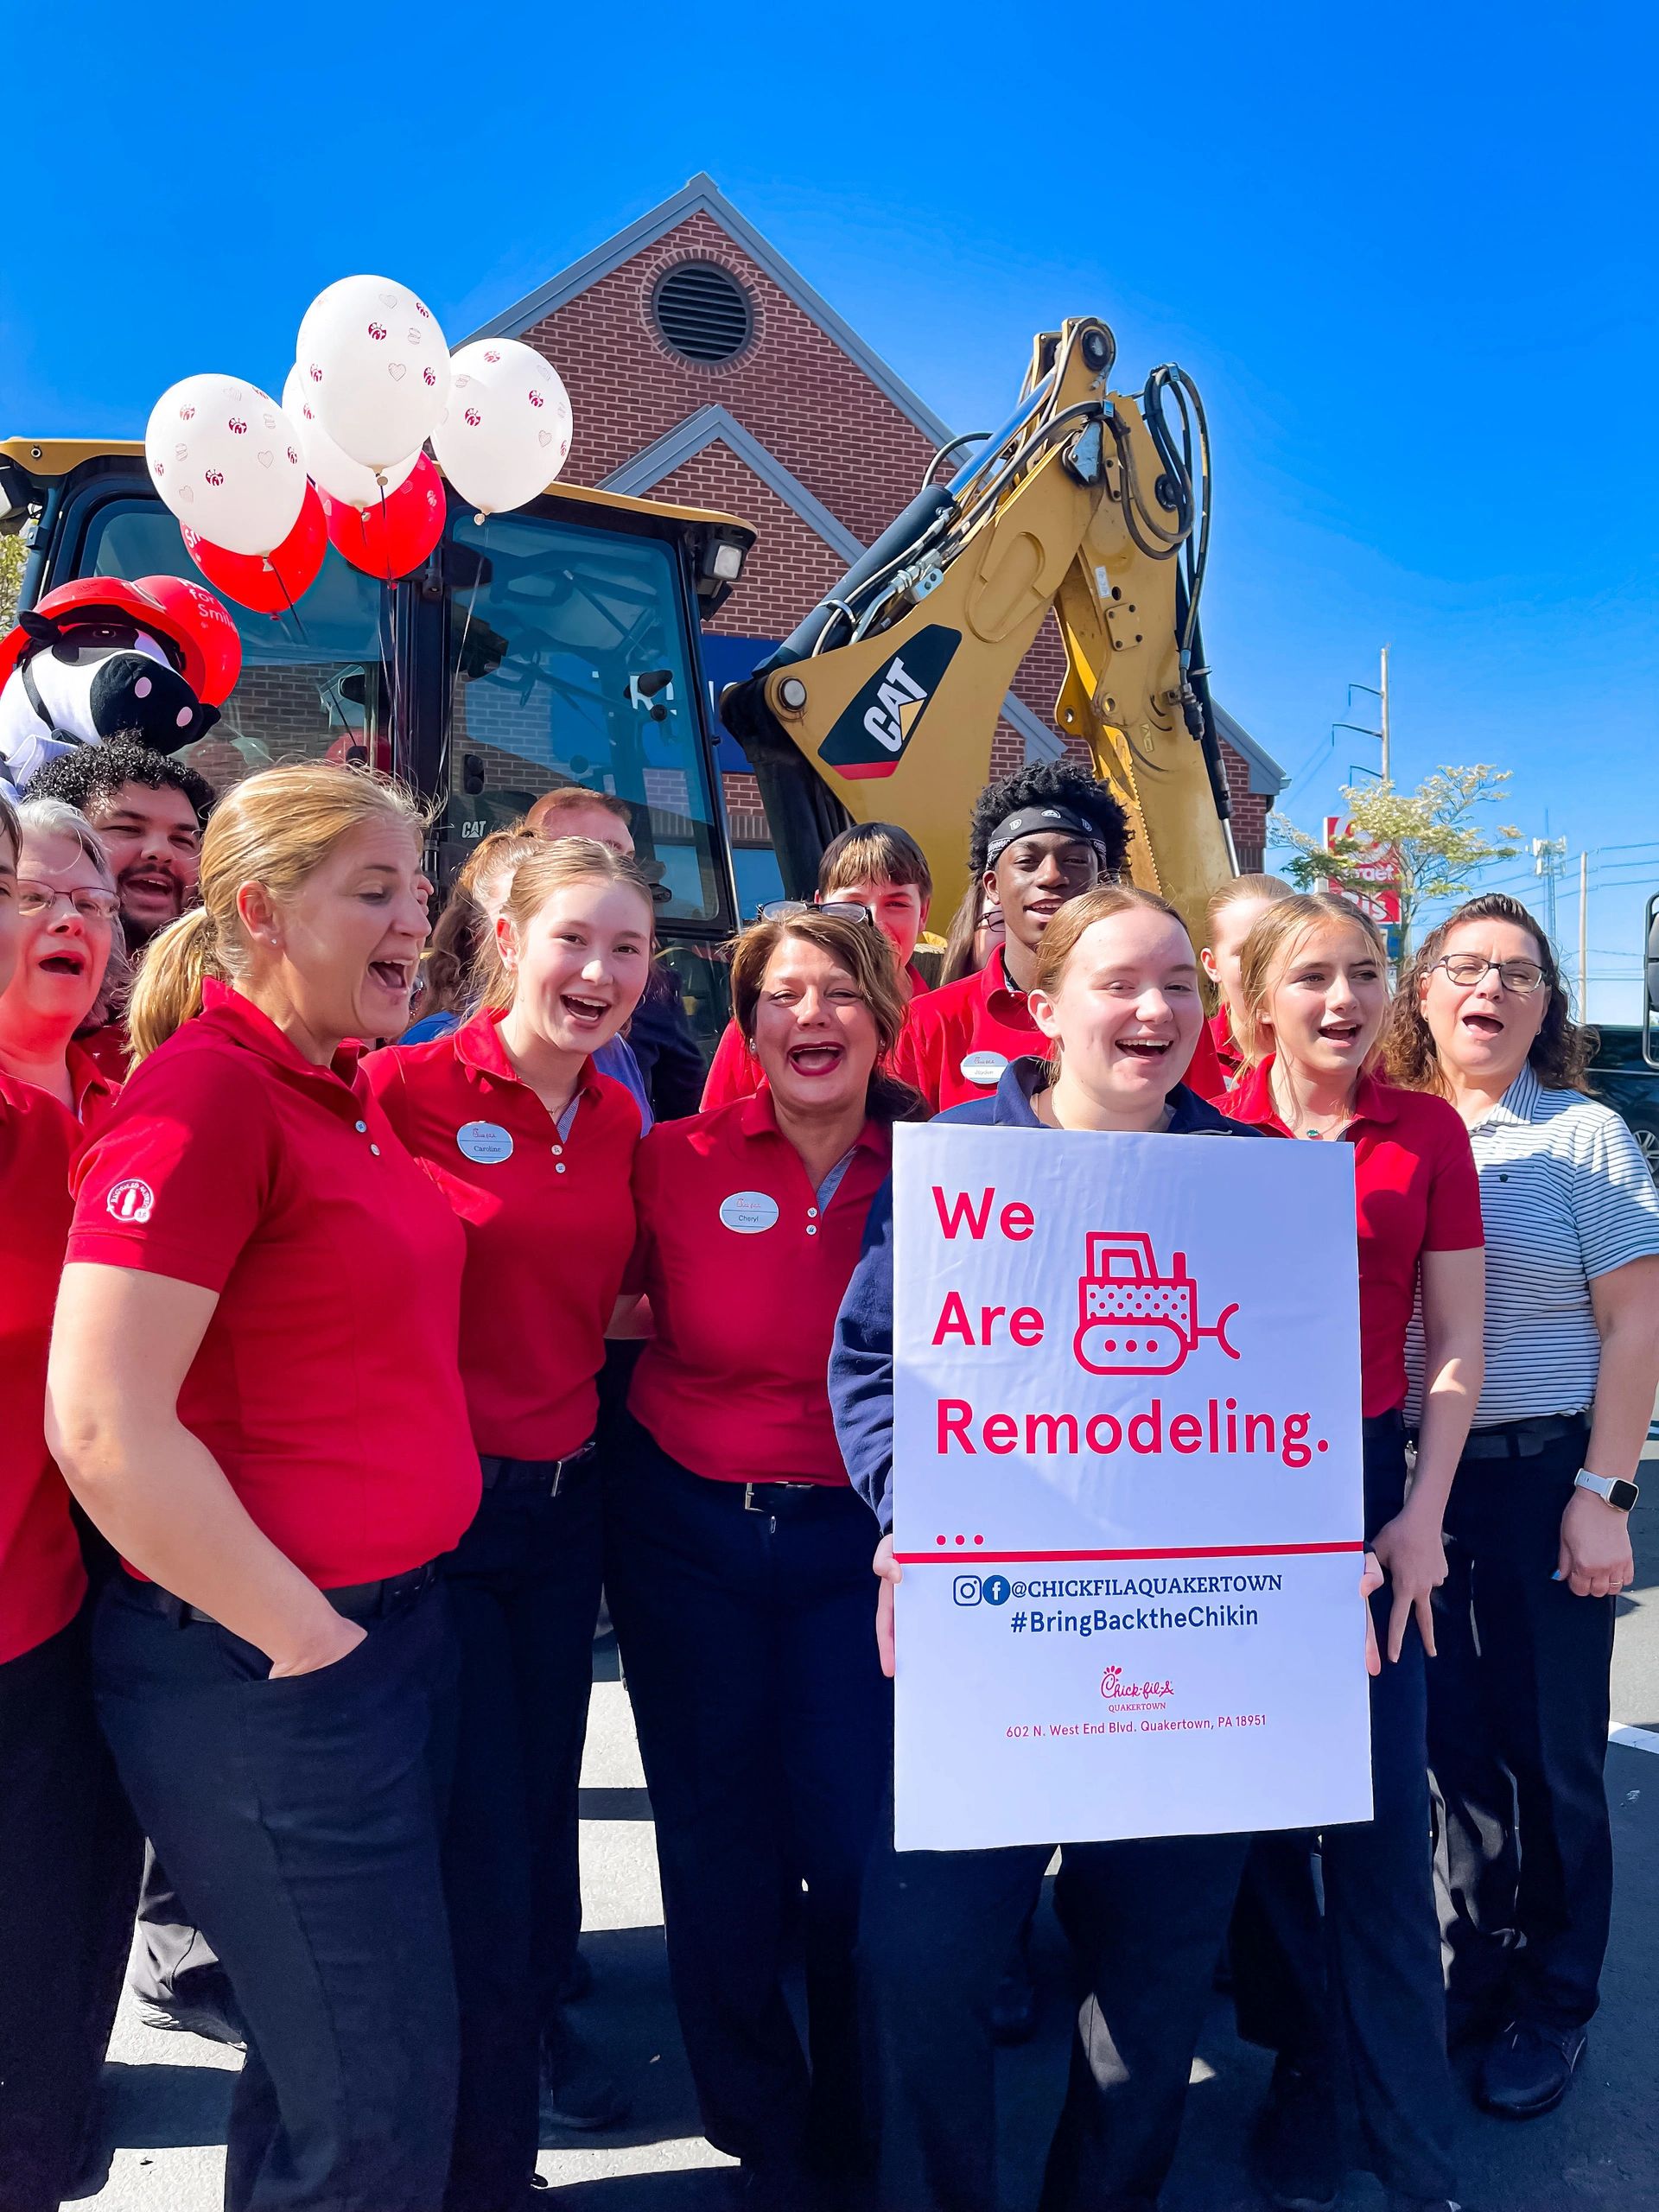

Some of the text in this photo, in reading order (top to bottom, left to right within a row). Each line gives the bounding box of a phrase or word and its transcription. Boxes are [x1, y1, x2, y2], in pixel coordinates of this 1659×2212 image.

[189, 589, 214, 604] for
[198, 604, 238, 633] Smil
[864, 657, 928, 752] CAT
[461, 821, 486, 838] CAT
[931, 1186, 1035, 1242] We
[931, 1291, 1045, 1347] Are
[937, 1397, 1329, 1468] Remodeling.
[1012, 1575, 1282, 1598] @CHICKFILAQUAKERTOWN
[1011, 1605, 1258, 1637] #BringBacktheChikin
[1100, 1665, 1174, 1700] Chick-fil-A
[1109, 1702, 1166, 1713] QUAKERTOWN
[1006, 1714, 1266, 1738] 602 N. West End Blvd. Quakertown, PA 18951
